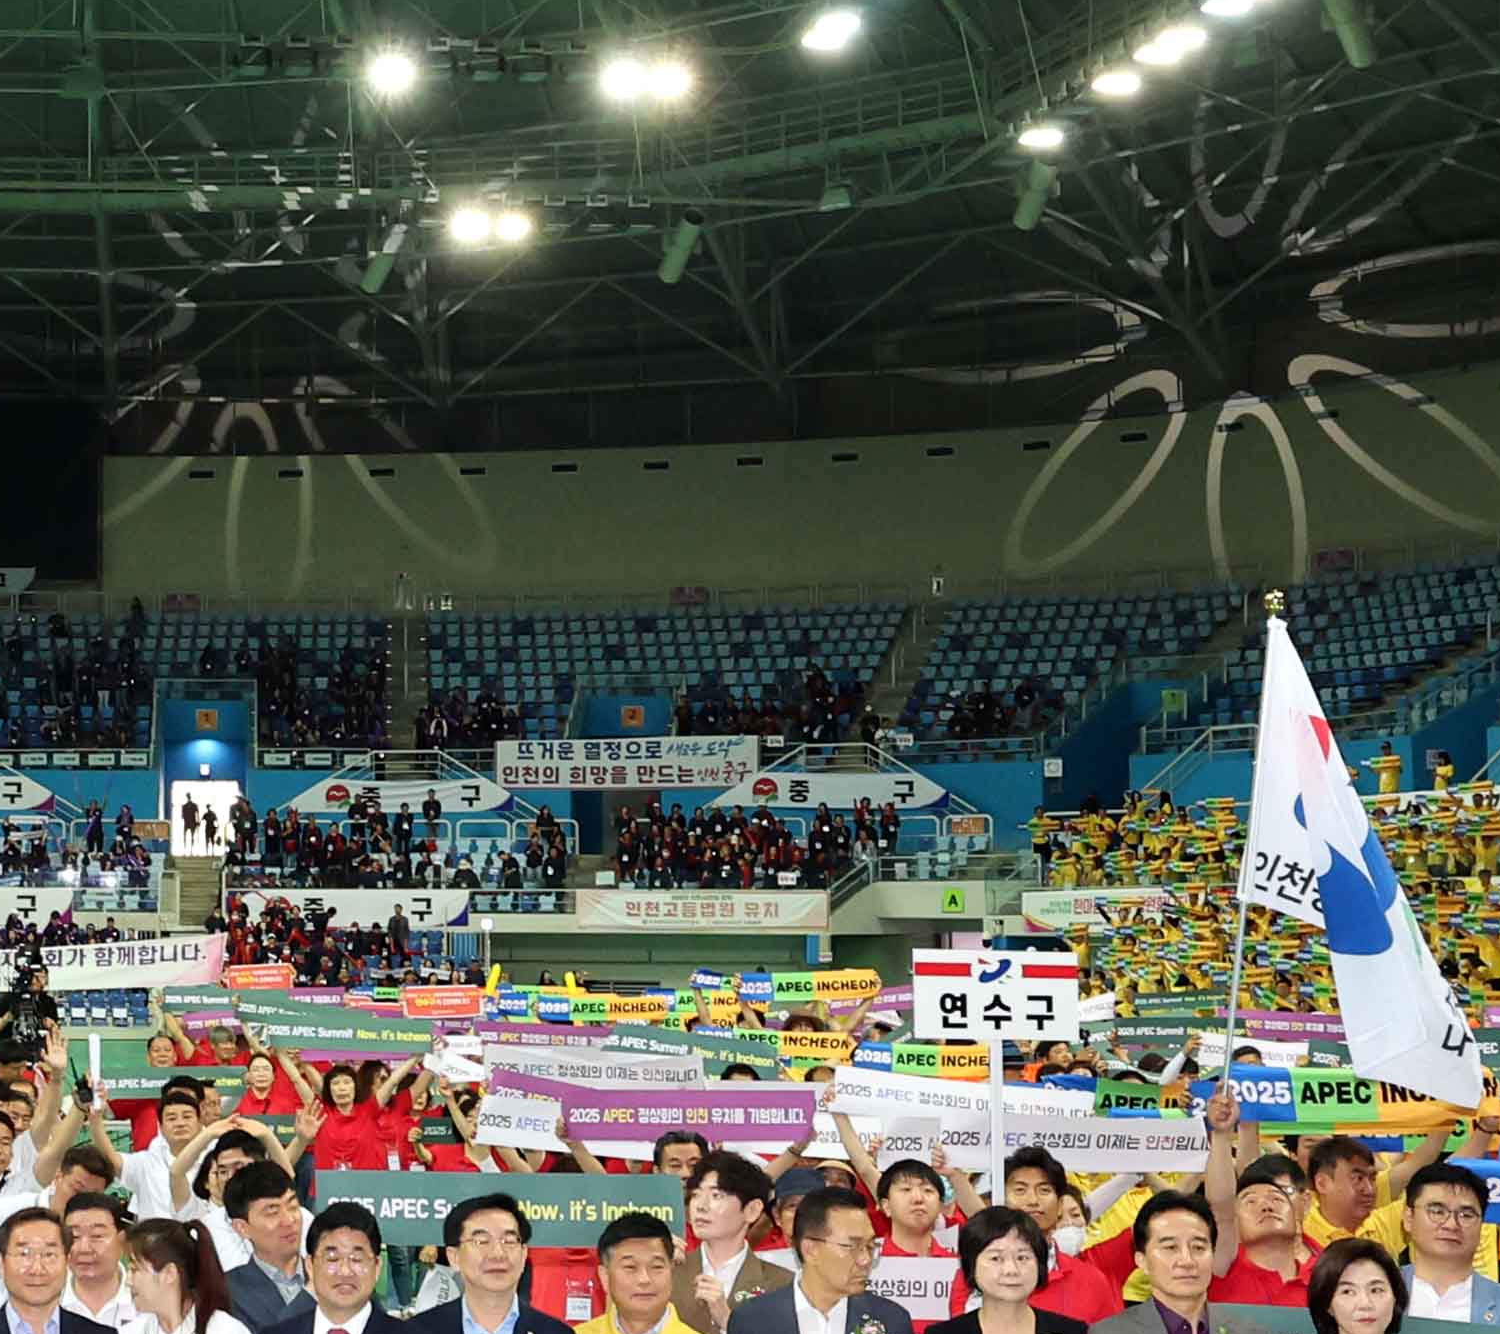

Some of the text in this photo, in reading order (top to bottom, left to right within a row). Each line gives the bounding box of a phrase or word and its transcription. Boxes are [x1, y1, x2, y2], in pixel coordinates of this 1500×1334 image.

[517, 741, 574, 760] 뜨거운
[584, 740, 663, 760] 열정으로
[502, 766, 560, 784] 인천의
[570, 766, 628, 784] 희망을
[637, 766, 694, 784] 만드는
[790, 781, 915, 802] 중구
[625, 901, 733, 917] 인천고등법원
[948, 894, 958, 909] A
[94, 940, 207, 964] 함께합니다.
[739, 978, 876, 995] 2025 APEC INCHEON
[939, 991, 1055, 1030] 연수구
[569, 1106, 808, 1124] 2025 APEC 정상회의 인천 유치를 기원합니다.
[941, 1129, 1140, 1151] 2025 정상회의 이제는
